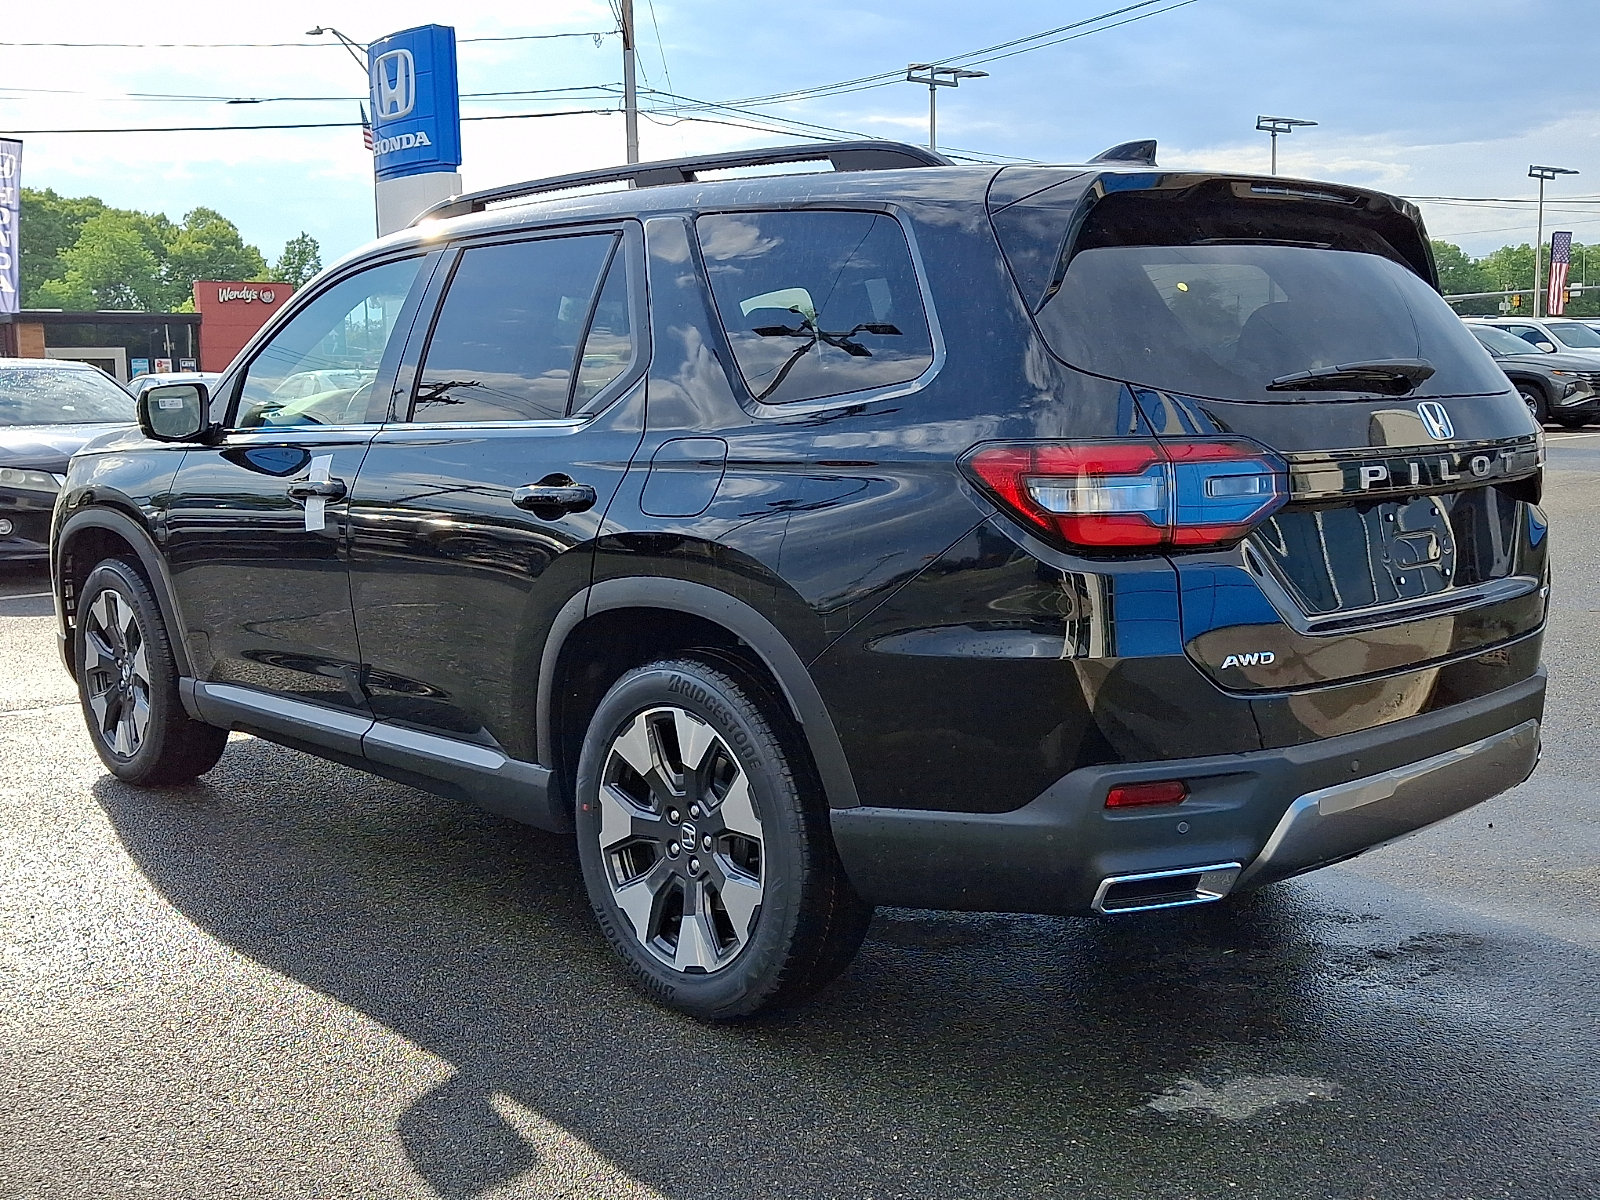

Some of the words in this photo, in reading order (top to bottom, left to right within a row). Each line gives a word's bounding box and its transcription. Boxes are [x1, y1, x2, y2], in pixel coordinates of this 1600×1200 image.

[373, 131, 432, 157] HONDA
[218, 286, 258, 303] Wendy's
[1360, 451, 1516, 490] PILOT
[1221, 651, 1275, 669] AWD
[667, 674, 761, 770] BRIDGESTONE
